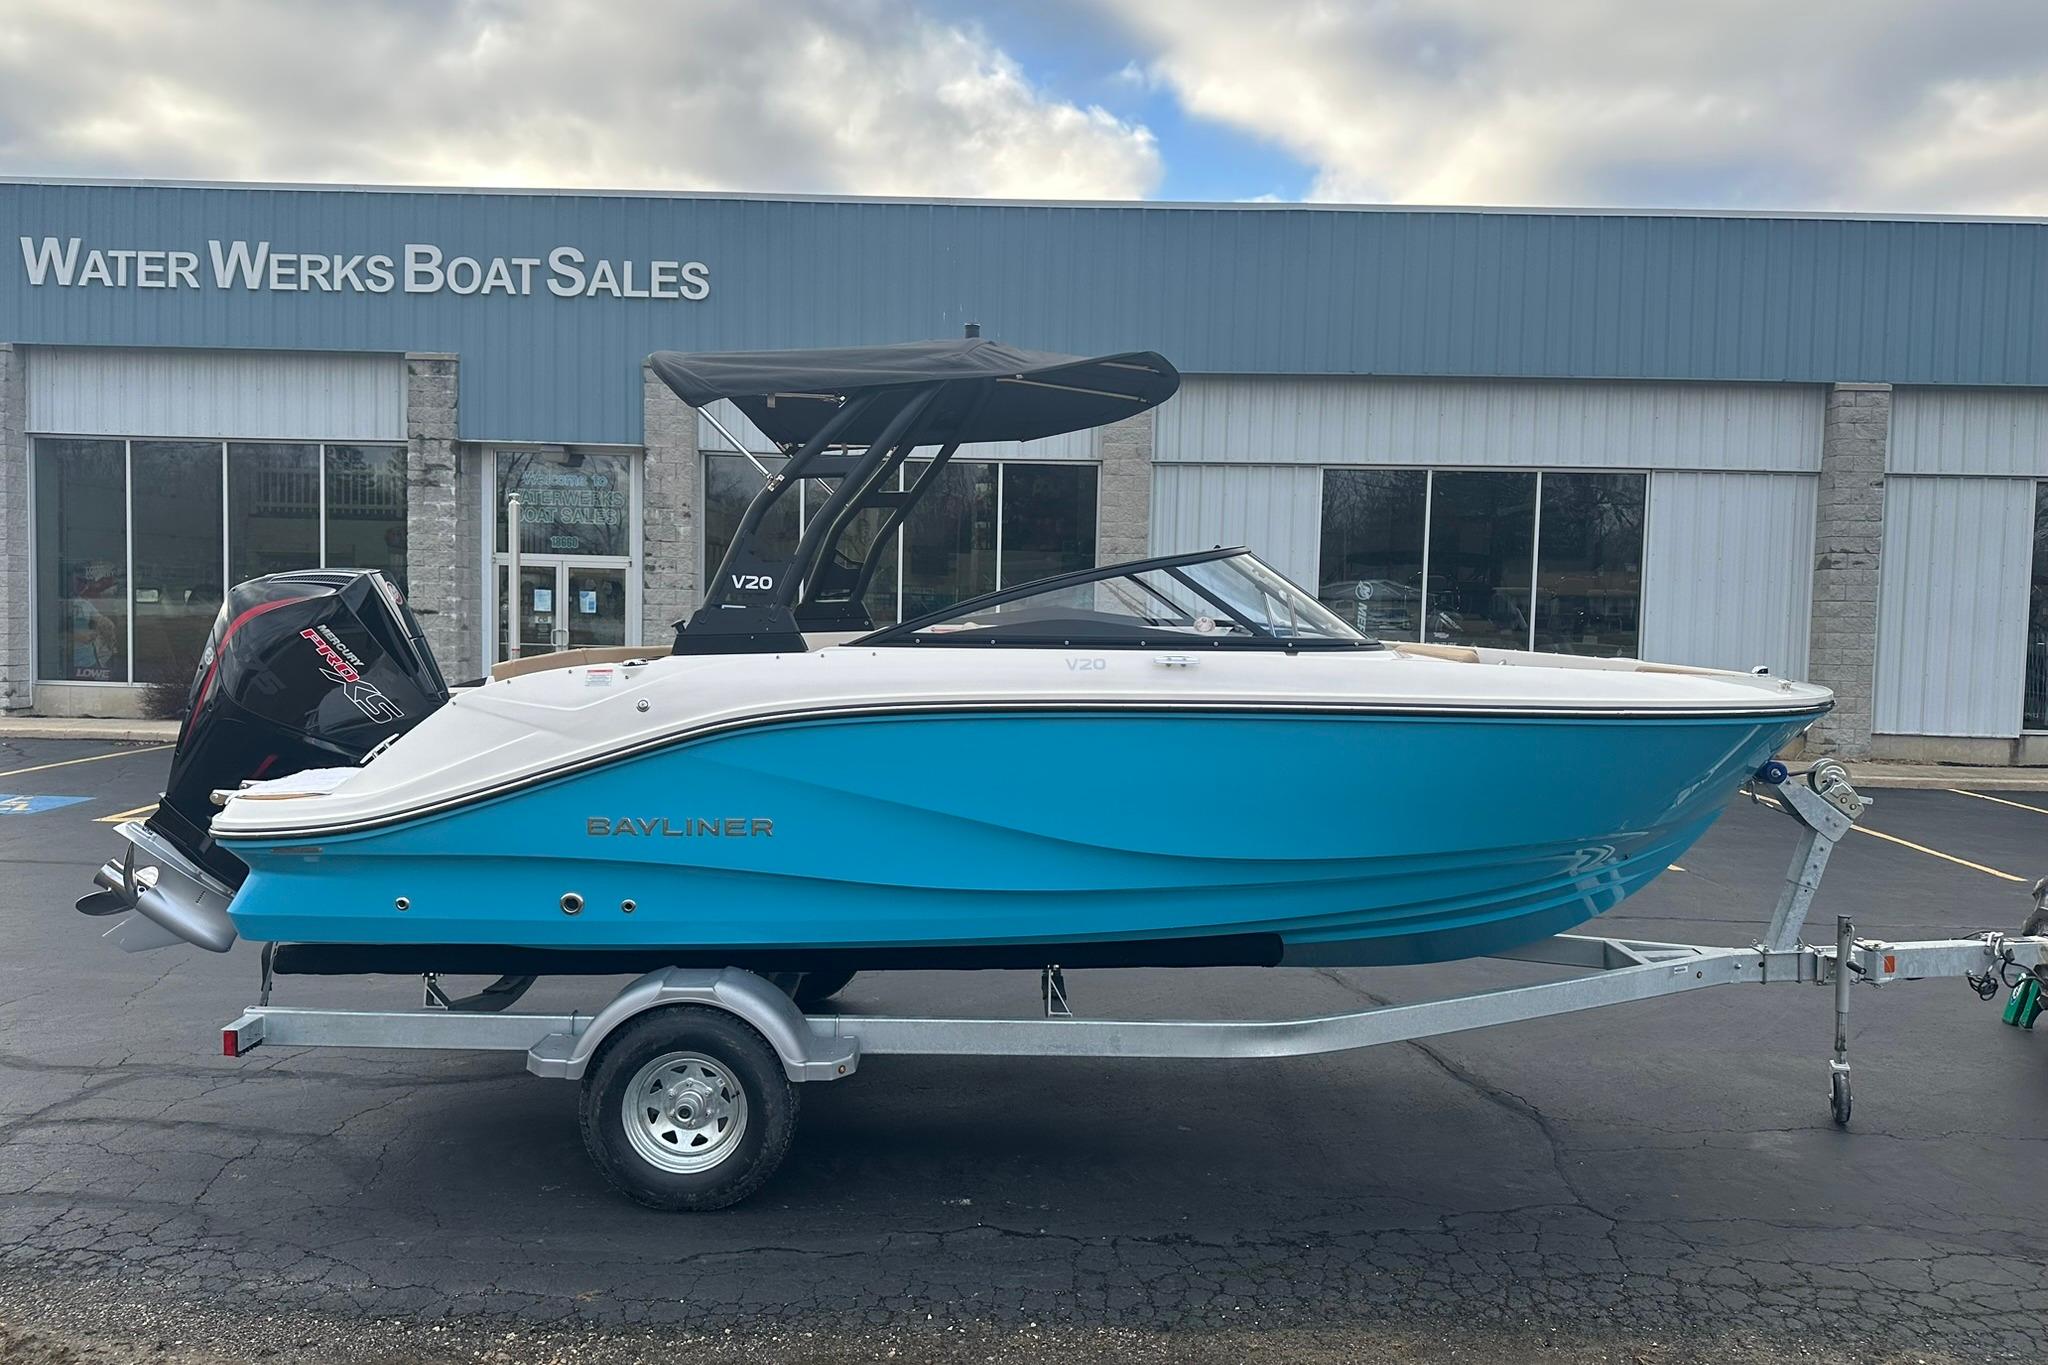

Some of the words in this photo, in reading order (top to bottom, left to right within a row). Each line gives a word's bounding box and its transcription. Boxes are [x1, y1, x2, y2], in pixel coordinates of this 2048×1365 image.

[20, 236, 200, 289] WATER
[208, 239, 395, 293] WERKS
[403, 243, 541, 295] BOAT
[546, 246, 710, 301] SALES
[522, 471, 588, 487] Welcome
[591, 473, 608, 487] to
[560, 506, 618, 526] SALES
[731, 574, 773, 590] V20
[299, 627, 360, 683] PRO
[316, 623, 365, 667] MERCURY
[76, 667, 111, 680] LOWE
[1065, 658, 1106, 671] V20
[587, 816, 774, 837] BAYLINER
